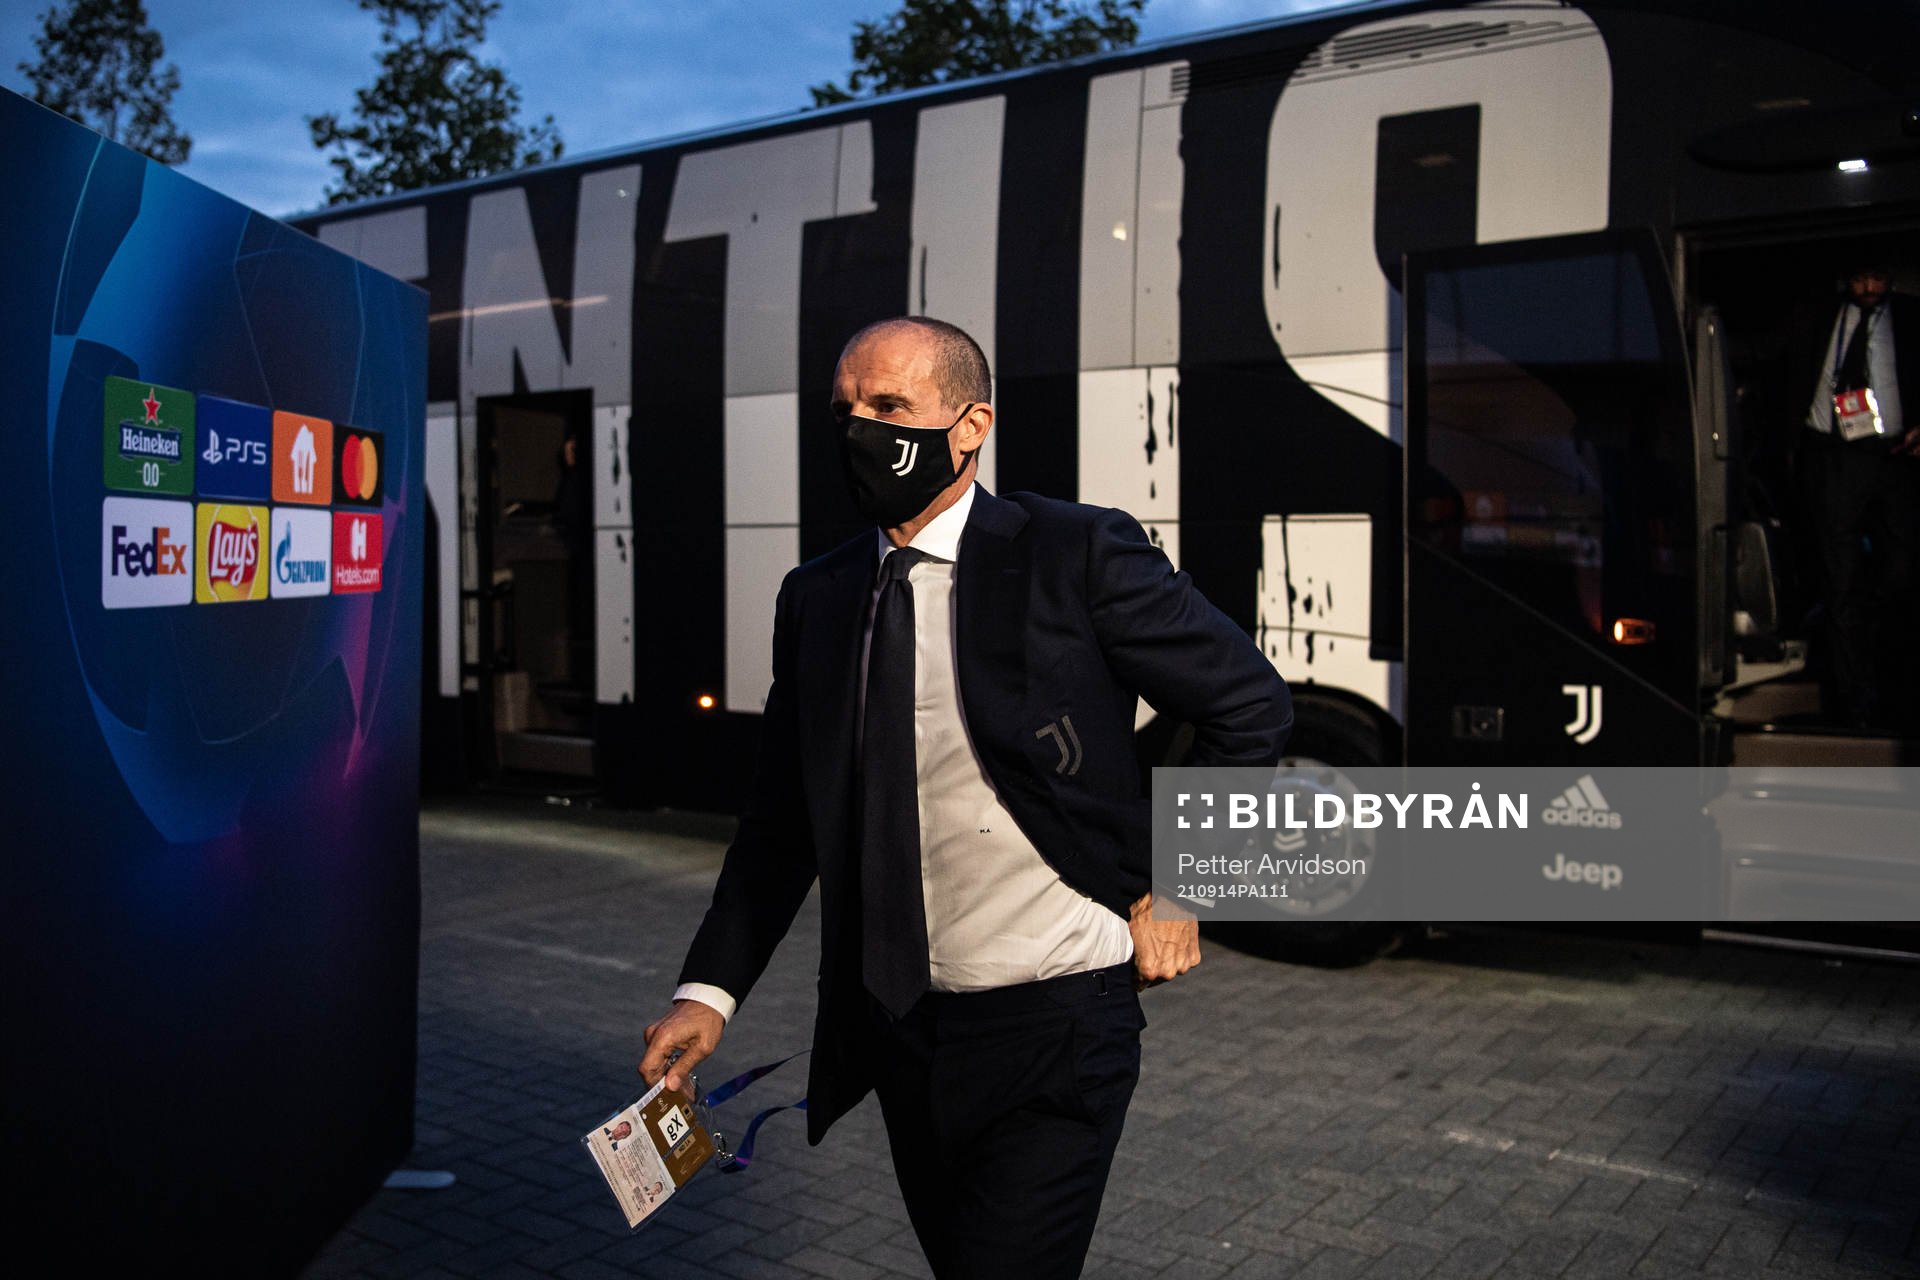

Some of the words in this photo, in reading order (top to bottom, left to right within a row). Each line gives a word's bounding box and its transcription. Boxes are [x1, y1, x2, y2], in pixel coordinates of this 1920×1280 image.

[122, 428, 179, 457] Heineken
[226, 438, 267, 465] PS5
[112, 526, 187, 576] FedEx
[212, 523, 257, 586] Lay's
[336, 565, 380, 585] Hotels.com
[1542, 806, 1622, 830] adidas
[1542, 853, 1622, 889] Jeep
